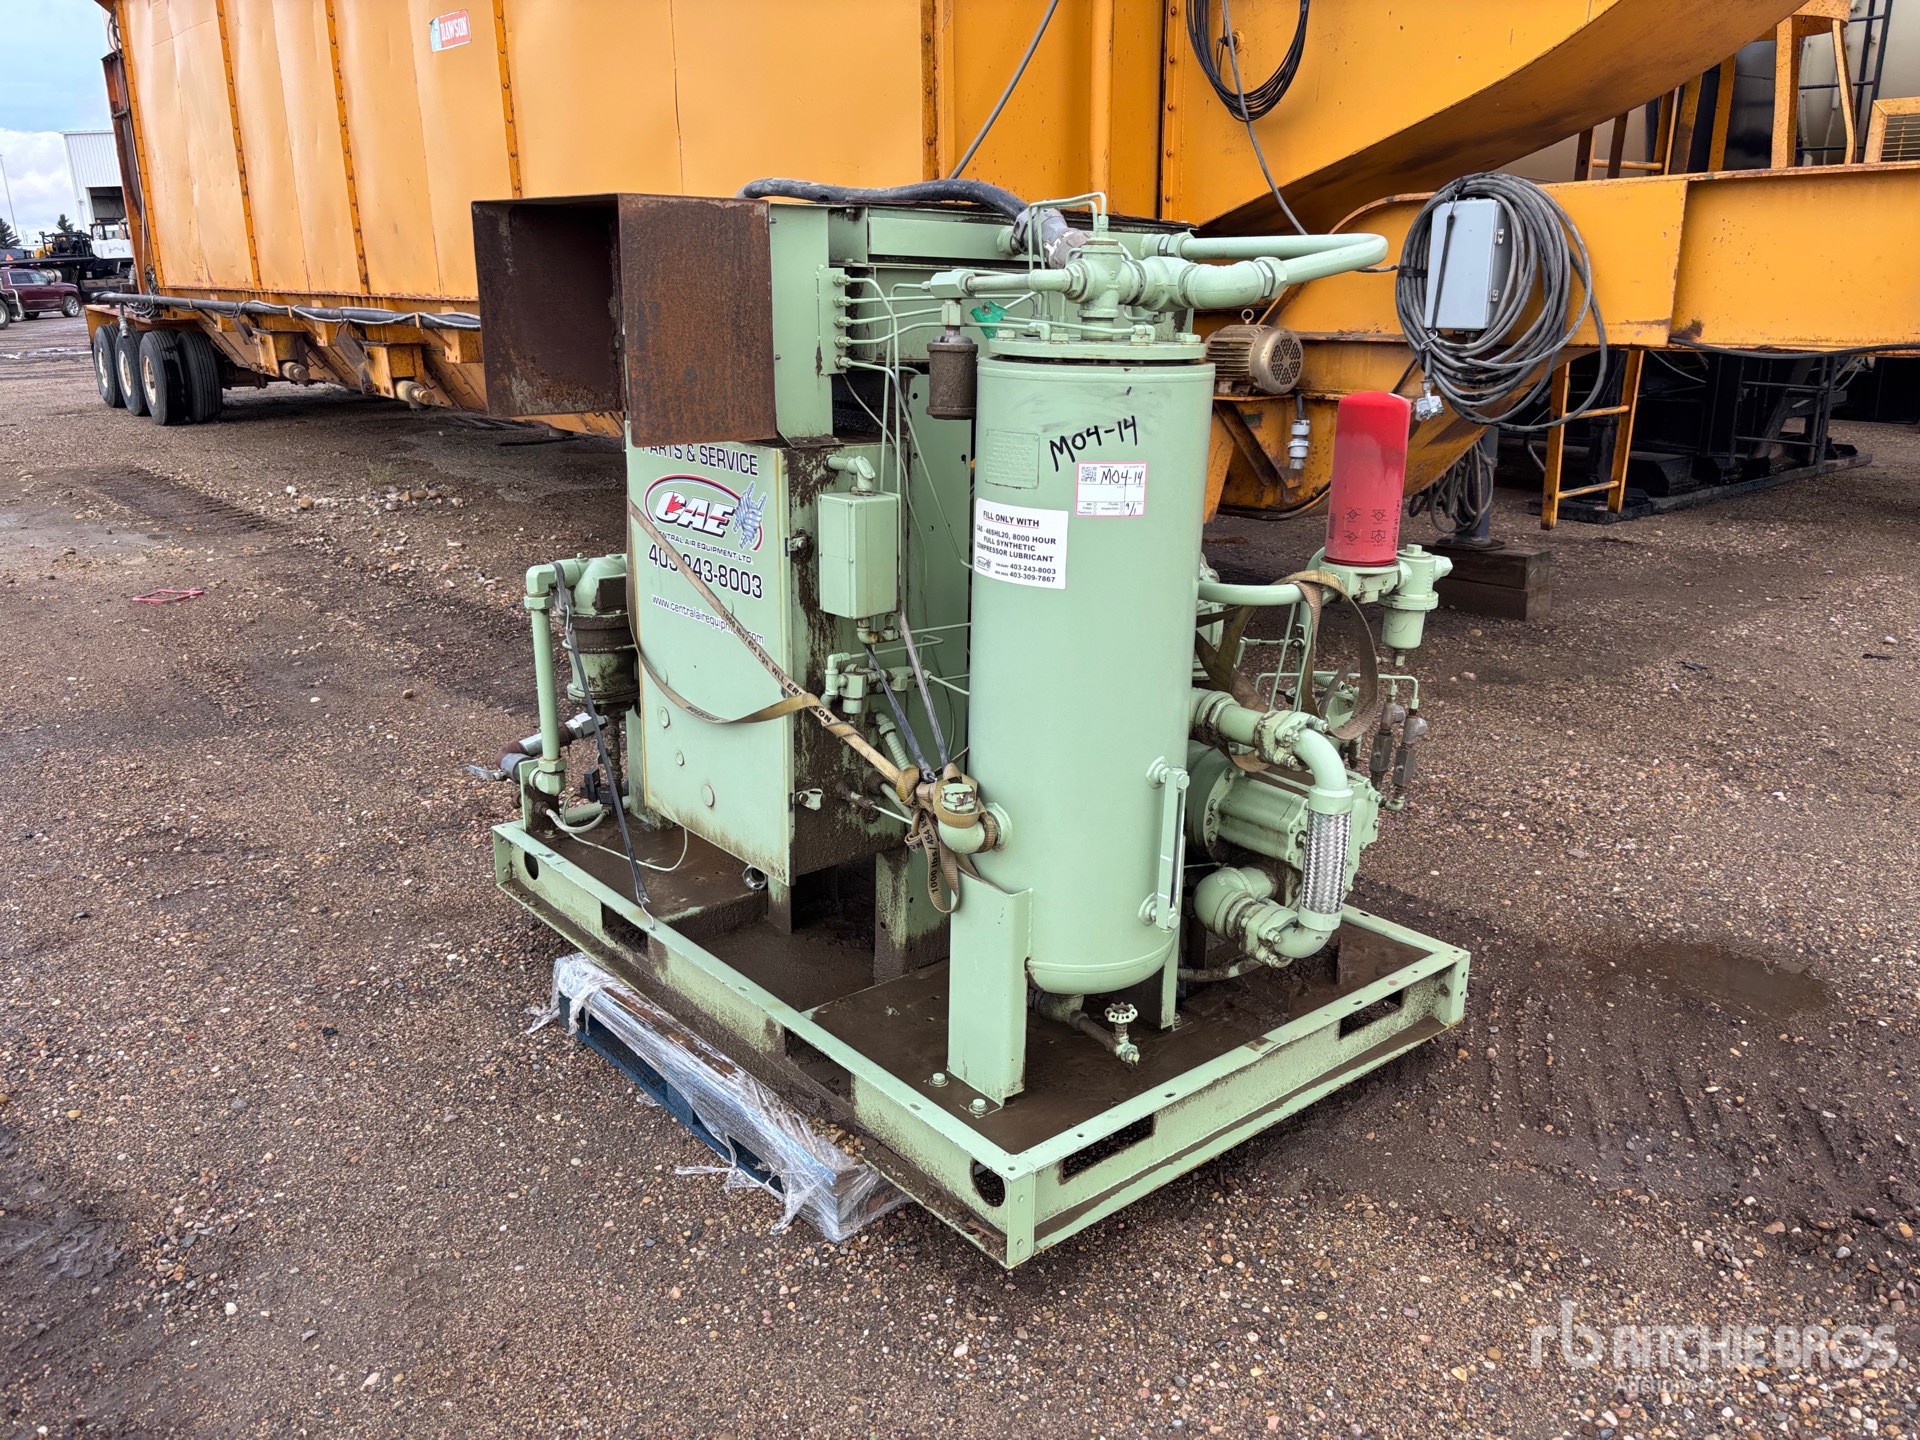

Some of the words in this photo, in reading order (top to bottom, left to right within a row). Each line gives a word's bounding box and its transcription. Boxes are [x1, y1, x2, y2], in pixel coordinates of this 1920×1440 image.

[1049, 415, 1137, 472] M04-14
[687, 444, 697, 462] &
[700, 445, 758, 476] SERVICE
[1100, 468, 1144, 486] M04-14
[655, 491, 735, 538] CAE
[983, 510, 994, 520] FILL
[995, 513, 1014, 524] ONLY
[1017, 517, 1040, 527] WITH
[659, 531, 684, 544] NTRAL
[685, 539, 696, 547] AIR
[696, 542, 737, 558] EQUIPMENT
[983, 536, 995, 545] FULL
[996, 539, 1036, 552] SYNTHETIC
[1012, 533, 1030, 542] 8000
[1032, 536, 1057, 545] HOUR
[976, 542, 1008, 556] COMPRESSOR
[1009, 551, 1054, 562] LUBRICANT
[649, 544, 762, 598] 40243-8003
[1010, 563, 1057, 575] 403-243-8003
[1010, 571, 1056, 583] 403-309-7867
[652, 596, 764, 644] www.centralairequipmcom
[722, 610, 736, 628] 1000
[748, 640, 758, 653] 454
[758, 650, 769, 666] kgs
[771, 665, 785, 684] WLL
[787, 683, 832, 723] ERSON
[923, 829, 934, 845] 454
[930, 870, 939, 893] 1000
